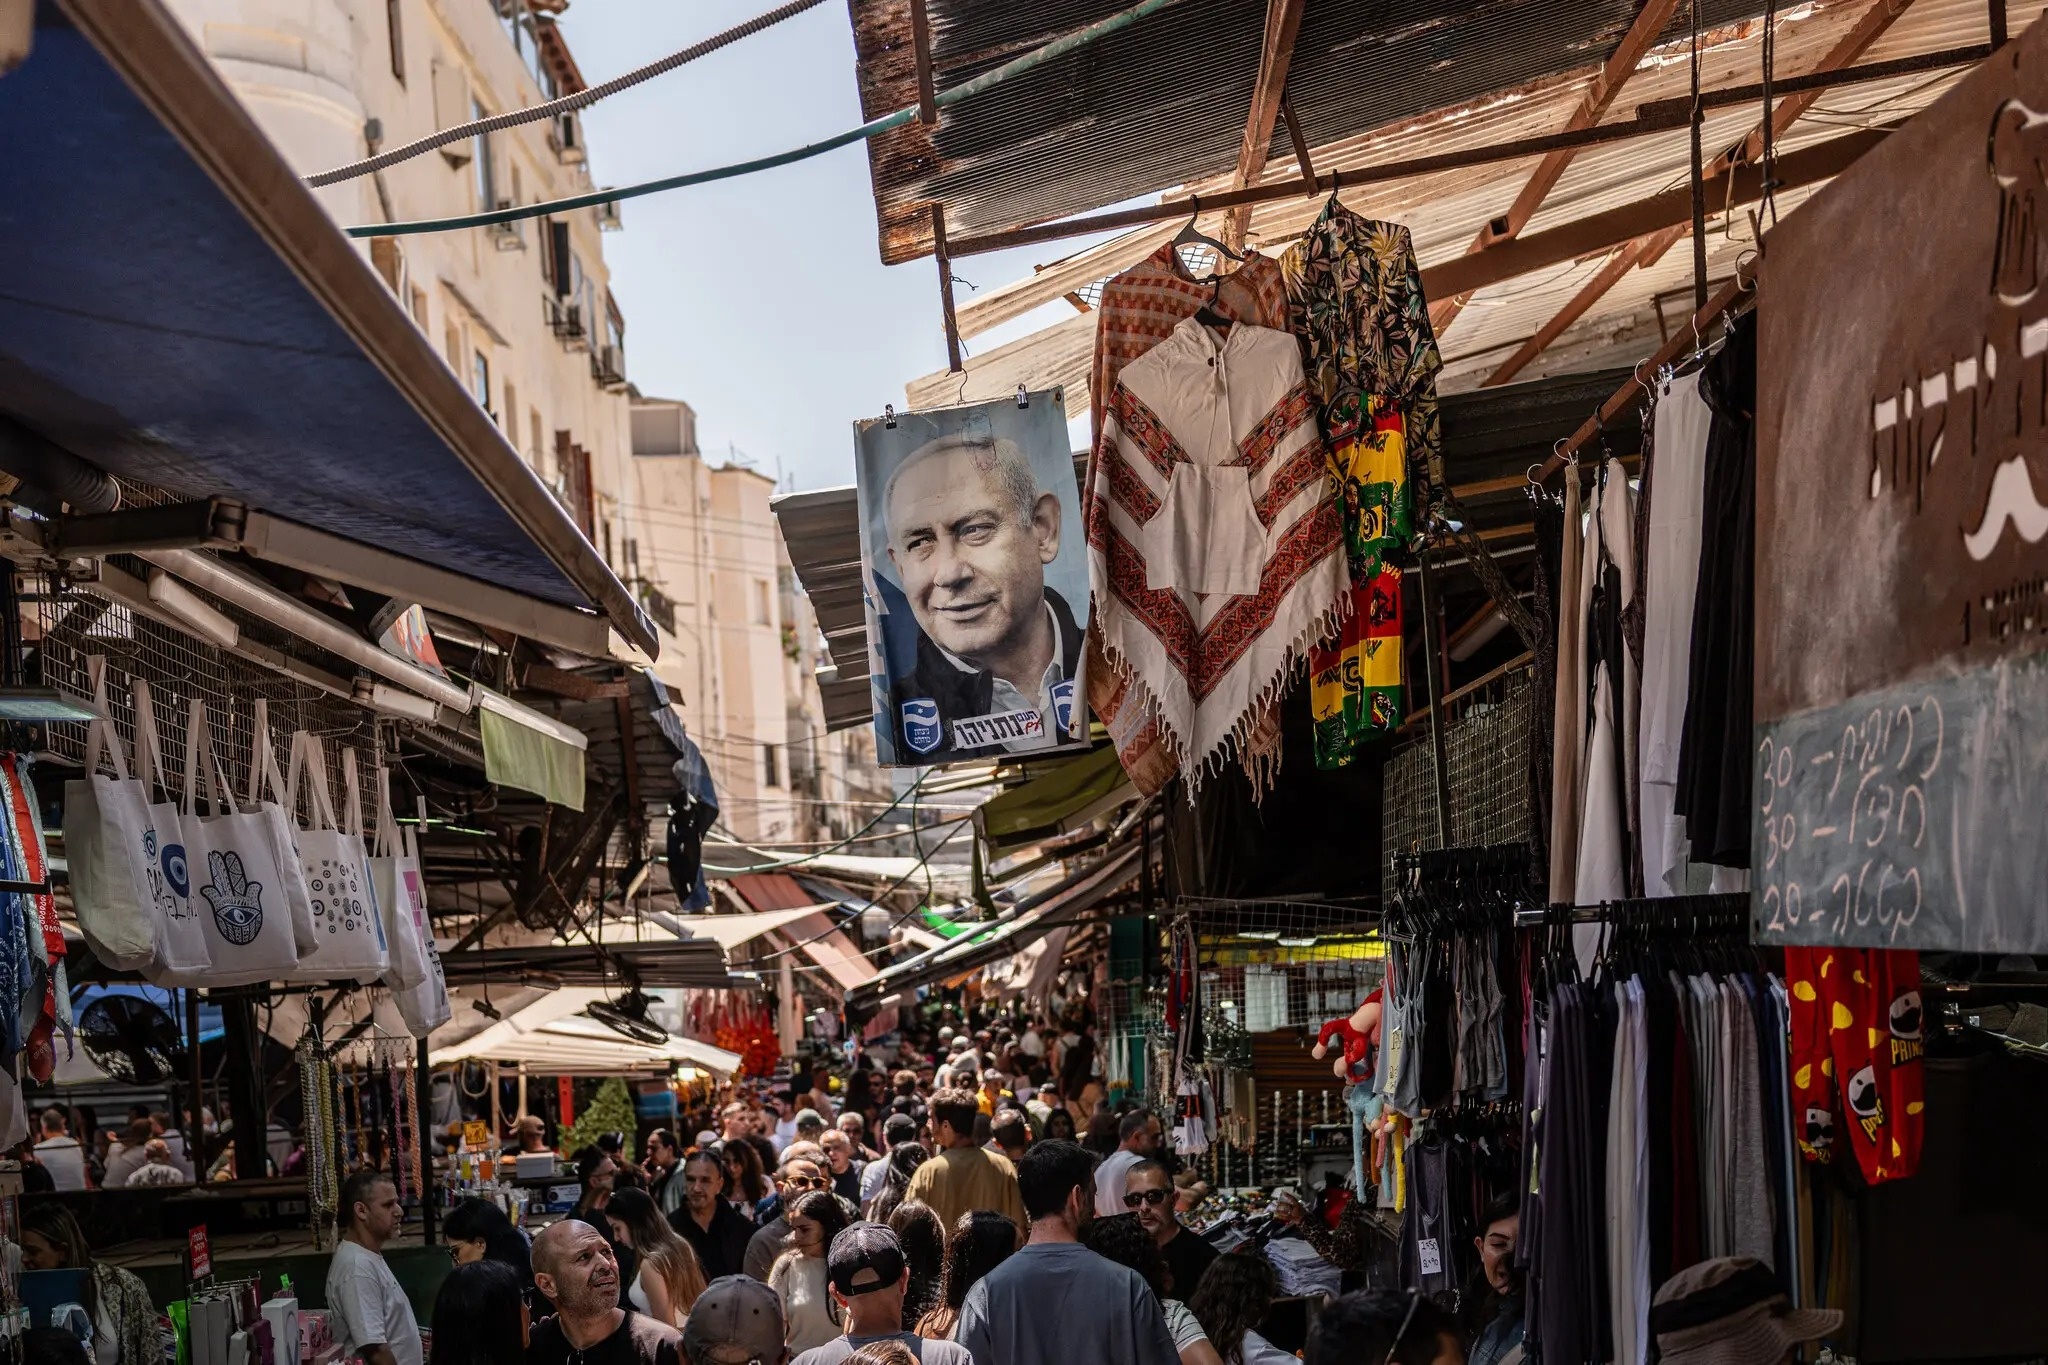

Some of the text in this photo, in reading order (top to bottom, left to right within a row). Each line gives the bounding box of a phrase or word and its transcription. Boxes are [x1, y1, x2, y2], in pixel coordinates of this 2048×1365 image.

[954, 714, 1025, 745] נתניהו
[1015, 710, 1039, 722] העם
[1759, 737, 1793, 815] 30
[1764, 813, 1795, 870] 30
[1763, 882, 1802, 933] 20
